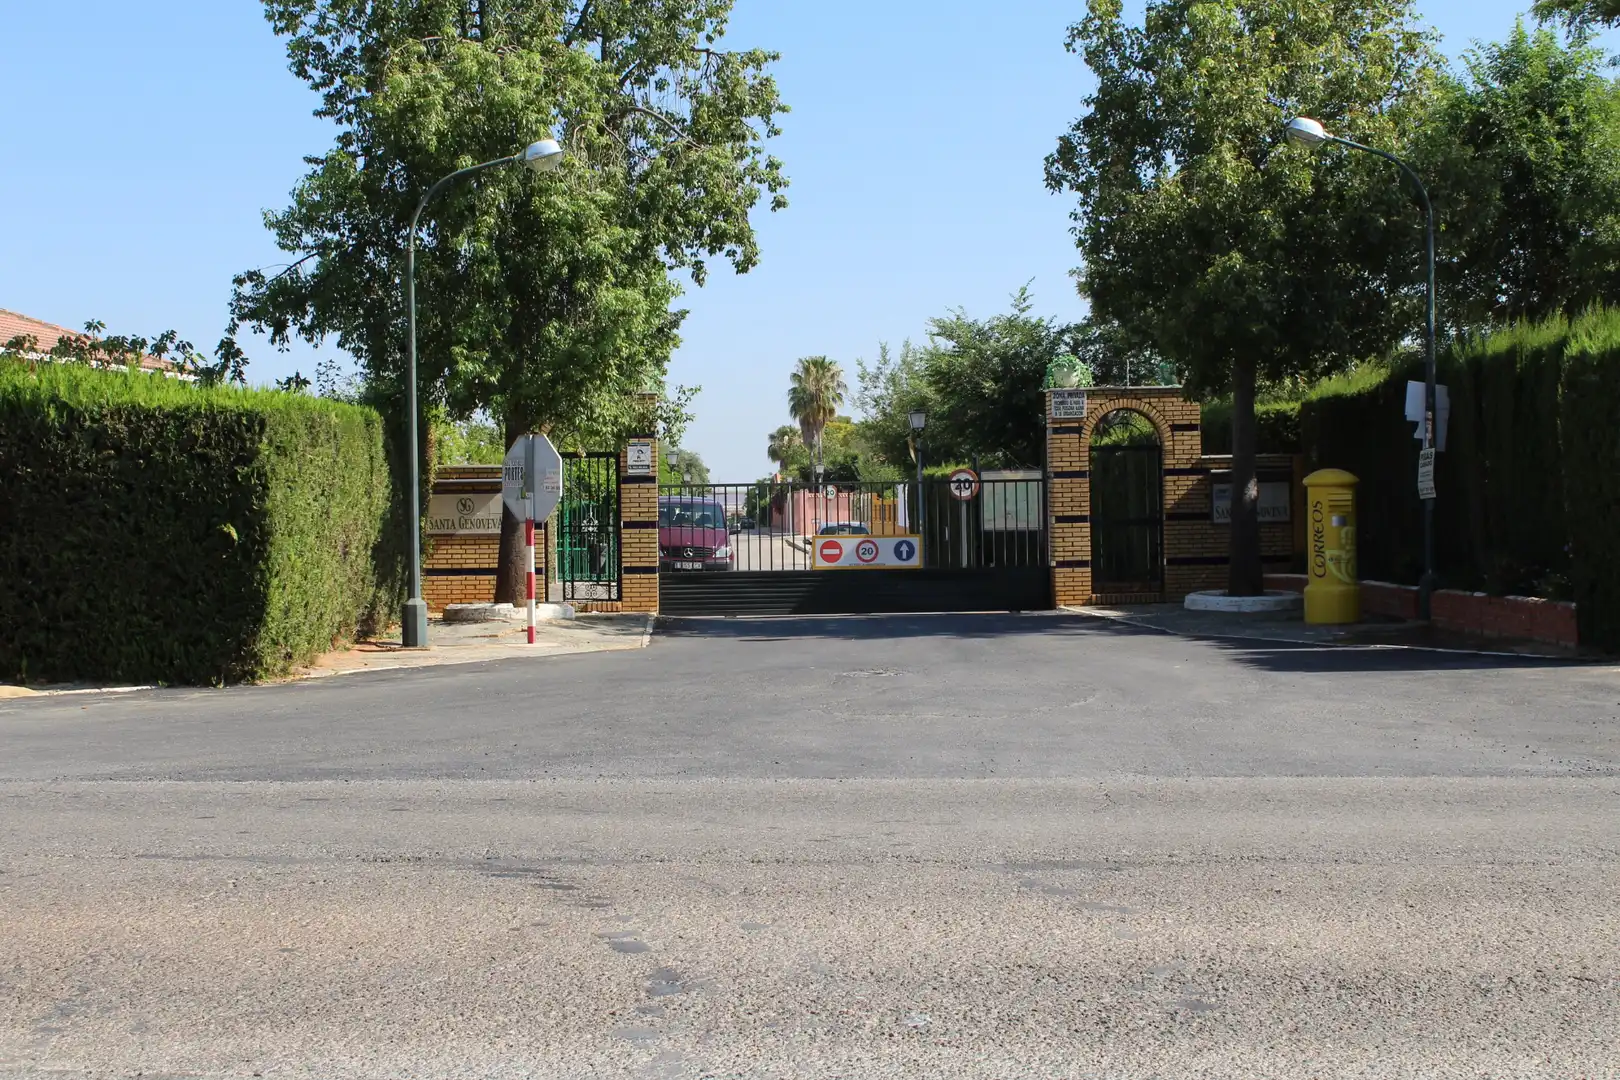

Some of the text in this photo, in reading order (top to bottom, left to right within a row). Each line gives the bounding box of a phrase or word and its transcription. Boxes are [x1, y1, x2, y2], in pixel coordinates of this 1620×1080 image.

[504, 466, 524, 481] PORTES
[955, 478, 971, 490] 20
[1215, 505, 1232, 520] SAN
[429, 516, 456, 530] SANTA
[1312, 500, 1327, 578] CORREOS
[861, 547, 874, 556] 20
